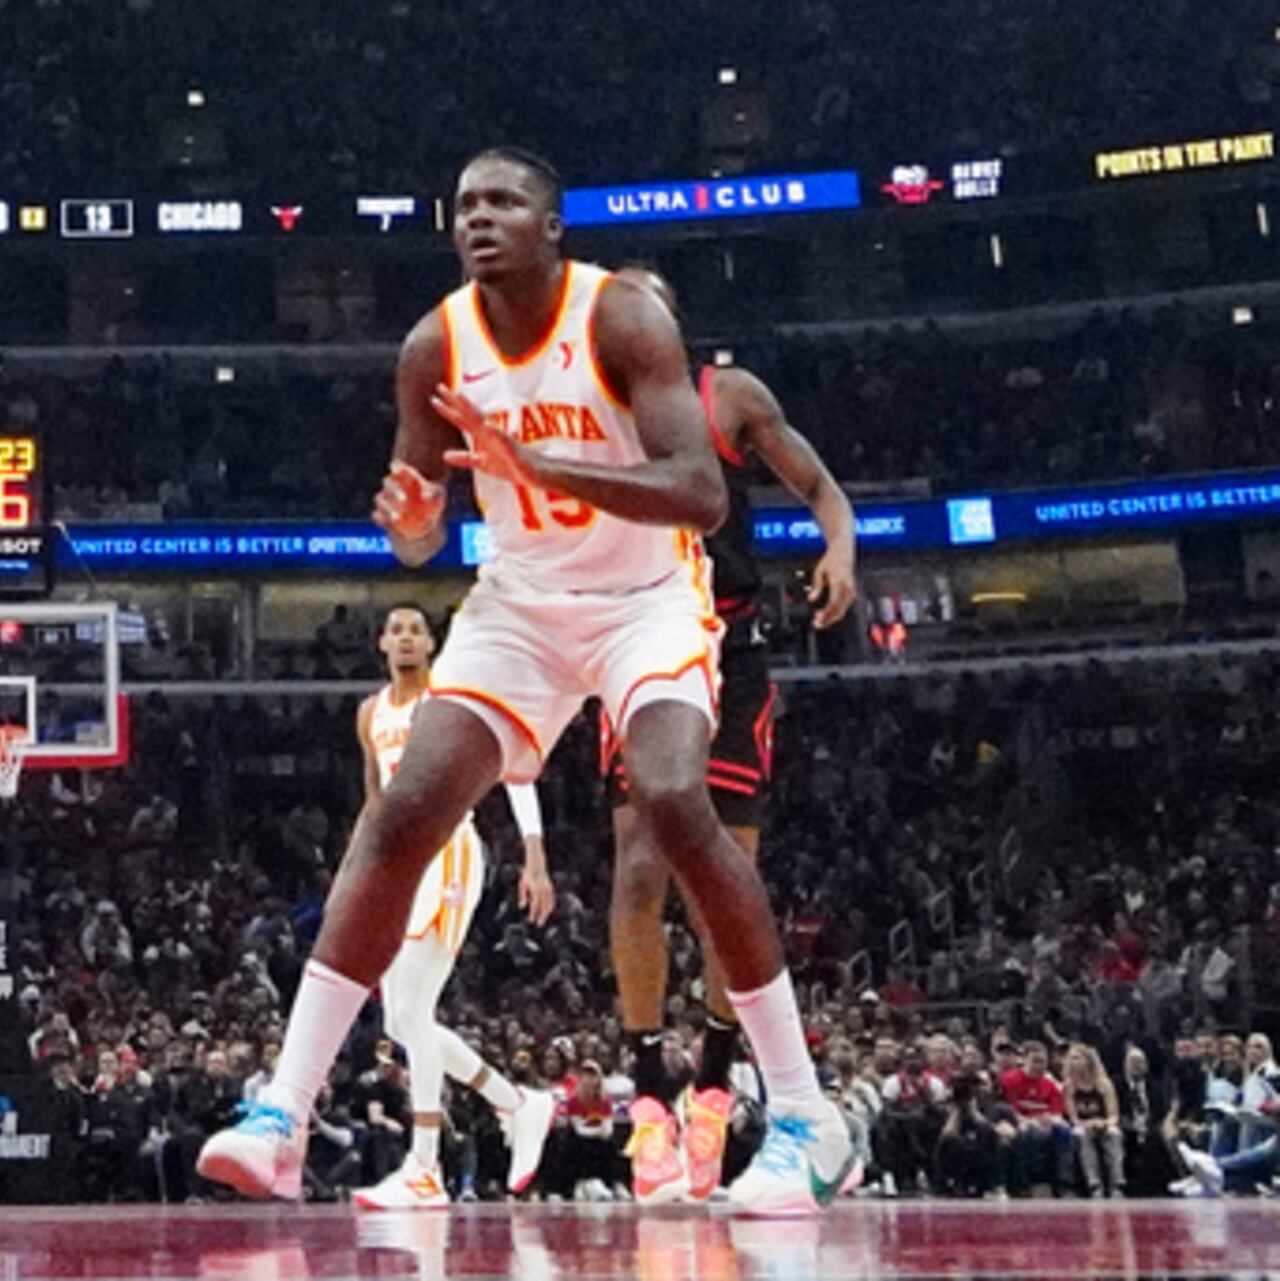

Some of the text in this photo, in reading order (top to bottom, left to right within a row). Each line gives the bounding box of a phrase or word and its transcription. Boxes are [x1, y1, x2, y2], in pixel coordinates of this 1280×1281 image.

[1096, 132, 1274, 179] POINTS IN THE PAINT
[607, 181, 807, 214] ULTRA CLUB
[158, 202, 241, 230] CHICAGO
[1036, 499, 1104, 522] UNITED
[1107, 493, 1183, 517] CENTER
[72, 537, 137, 555] UNITED
[140, 537, 201, 555] CENTER
[214, 537, 233, 555] IS
[238, 536, 304, 555] BETTER
